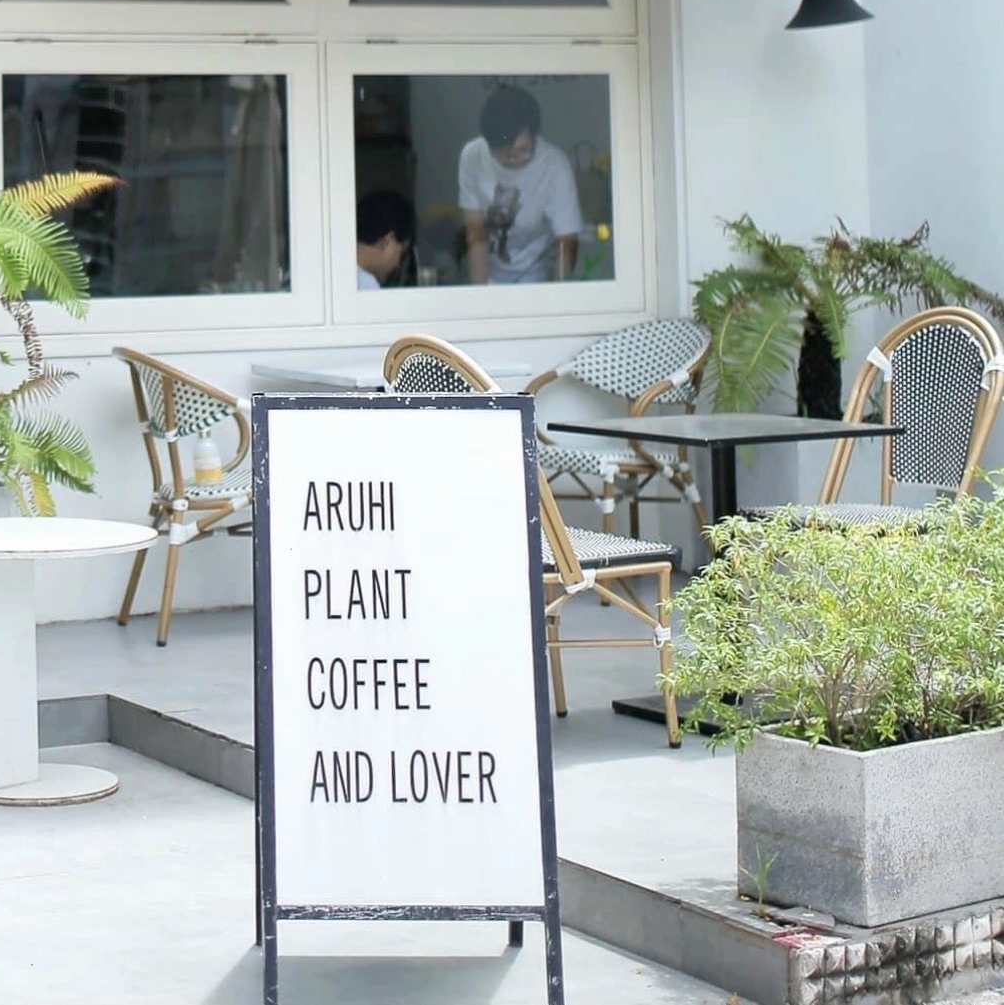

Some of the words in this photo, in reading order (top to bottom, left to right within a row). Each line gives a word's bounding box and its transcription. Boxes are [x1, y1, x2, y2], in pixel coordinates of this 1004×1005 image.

[304, 482, 394, 531] ARUHI
[305, 570, 411, 619] PLANT
[308, 658, 430, 709] COFFEE
[311, 751, 373, 802] AND
[392, 750, 496, 802] LOVER
